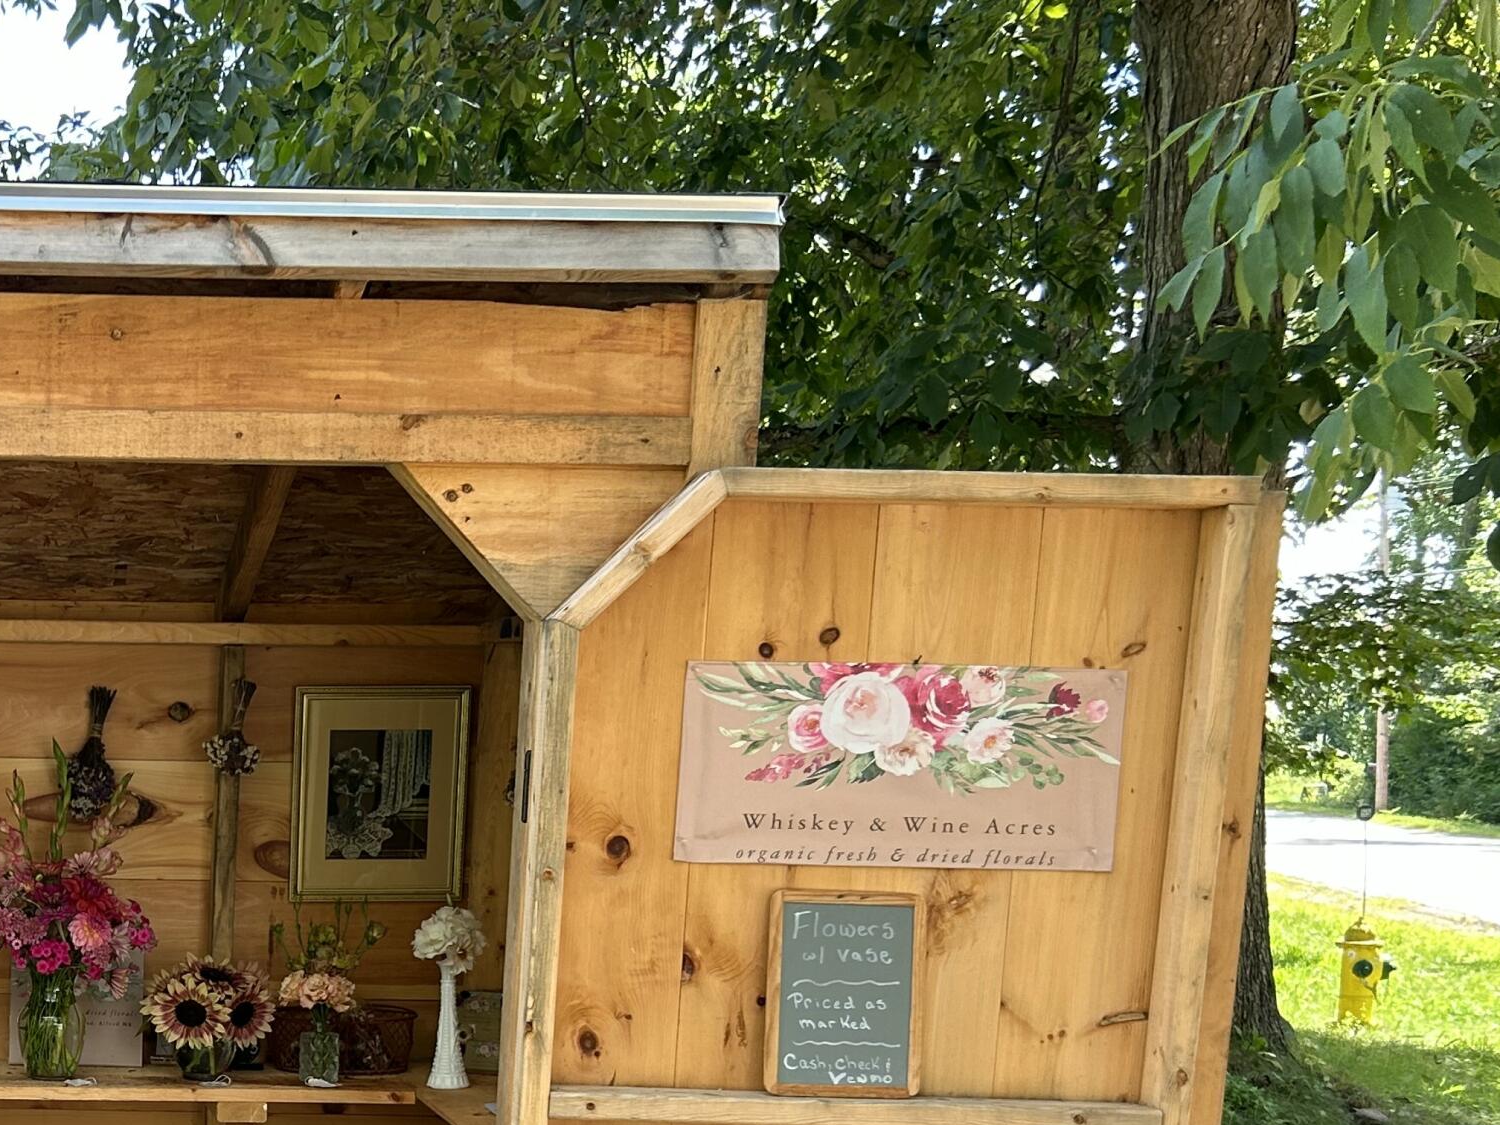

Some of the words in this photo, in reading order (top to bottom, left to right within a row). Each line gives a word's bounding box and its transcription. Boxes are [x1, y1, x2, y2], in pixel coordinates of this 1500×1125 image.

[743, 813, 855, 835] Whiskey
[869, 817, 887, 832] &
[903, 816, 971, 834] Wine
[985, 817, 1056, 836] Acres
[735, 846, 815, 863] organic
[823, 845, 878, 864] fresh
[891, 848, 905, 863] &
[917, 847, 973, 864] dried
[981, 848, 1056, 868] florals
[792, 911, 895, 939] Flowers
[786, 991, 856, 1010] Priced
[865, 999, 888, 1011] as
[828, 1071, 893, 1085] Venmo
